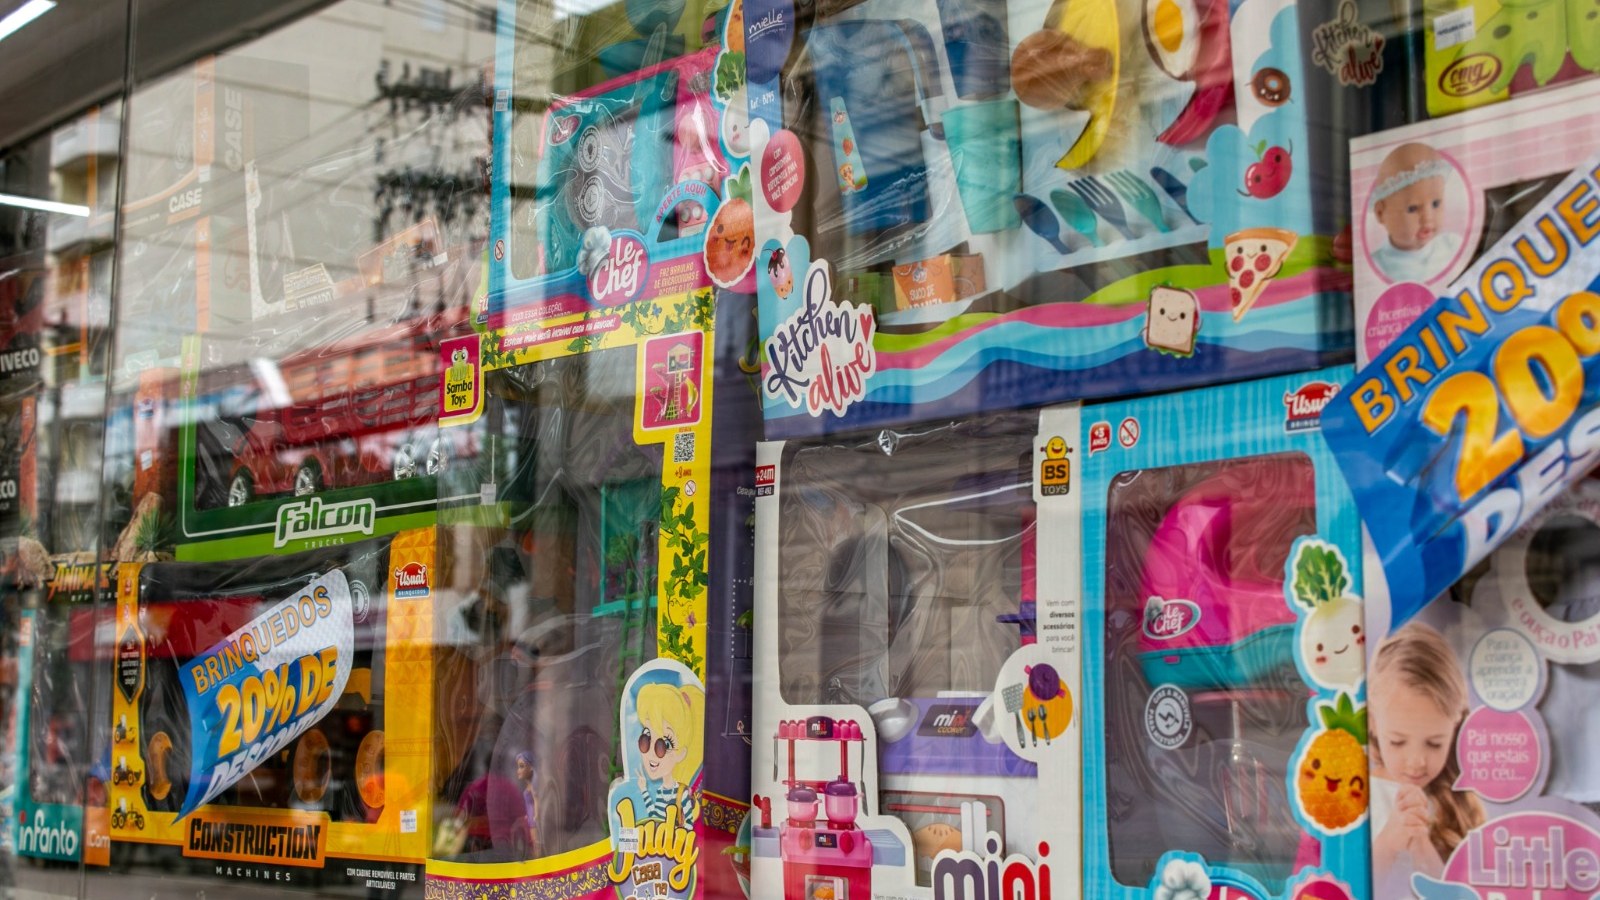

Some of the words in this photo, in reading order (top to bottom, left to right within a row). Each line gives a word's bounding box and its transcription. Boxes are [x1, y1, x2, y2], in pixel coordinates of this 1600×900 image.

[749, 8, 783, 34] mielle
[224, 86, 242, 172] CASE
[169, 188, 202, 213] CASE
[592, 248, 644, 301] Chef
[1350, 163, 1600, 432] BRINQUE
[0, 348, 39, 372] IVECO
[446, 380, 473, 395] Samba
[808, 342, 872, 411] alive
[451, 394, 467, 407] Toys
[1044, 464, 1067, 480] BS
[1043, 484, 1067, 495] TOYS
[304, 537, 345, 549] TRUCKS
[395, 566, 426, 586] Usual
[1153, 611, 1185, 634] Chef
[191, 585, 332, 694] BRINQUEDOS
[216, 663, 296, 758] 20%
[297, 645, 338, 717] DE
[1467, 728, 1487, 746] Pai
[1491, 731, 1527, 747] nosso
[1467, 751, 1492, 767] que
[1495, 749, 1529, 763] estais
[1472, 767, 1488, 780] no
[19, 809, 78, 856] infanto
[933, 838, 1051, 900] mini
[1468, 825, 1600, 892] Little
[215, 866, 291, 882] MACHINES
[400, 872, 416, 882] PARTES
